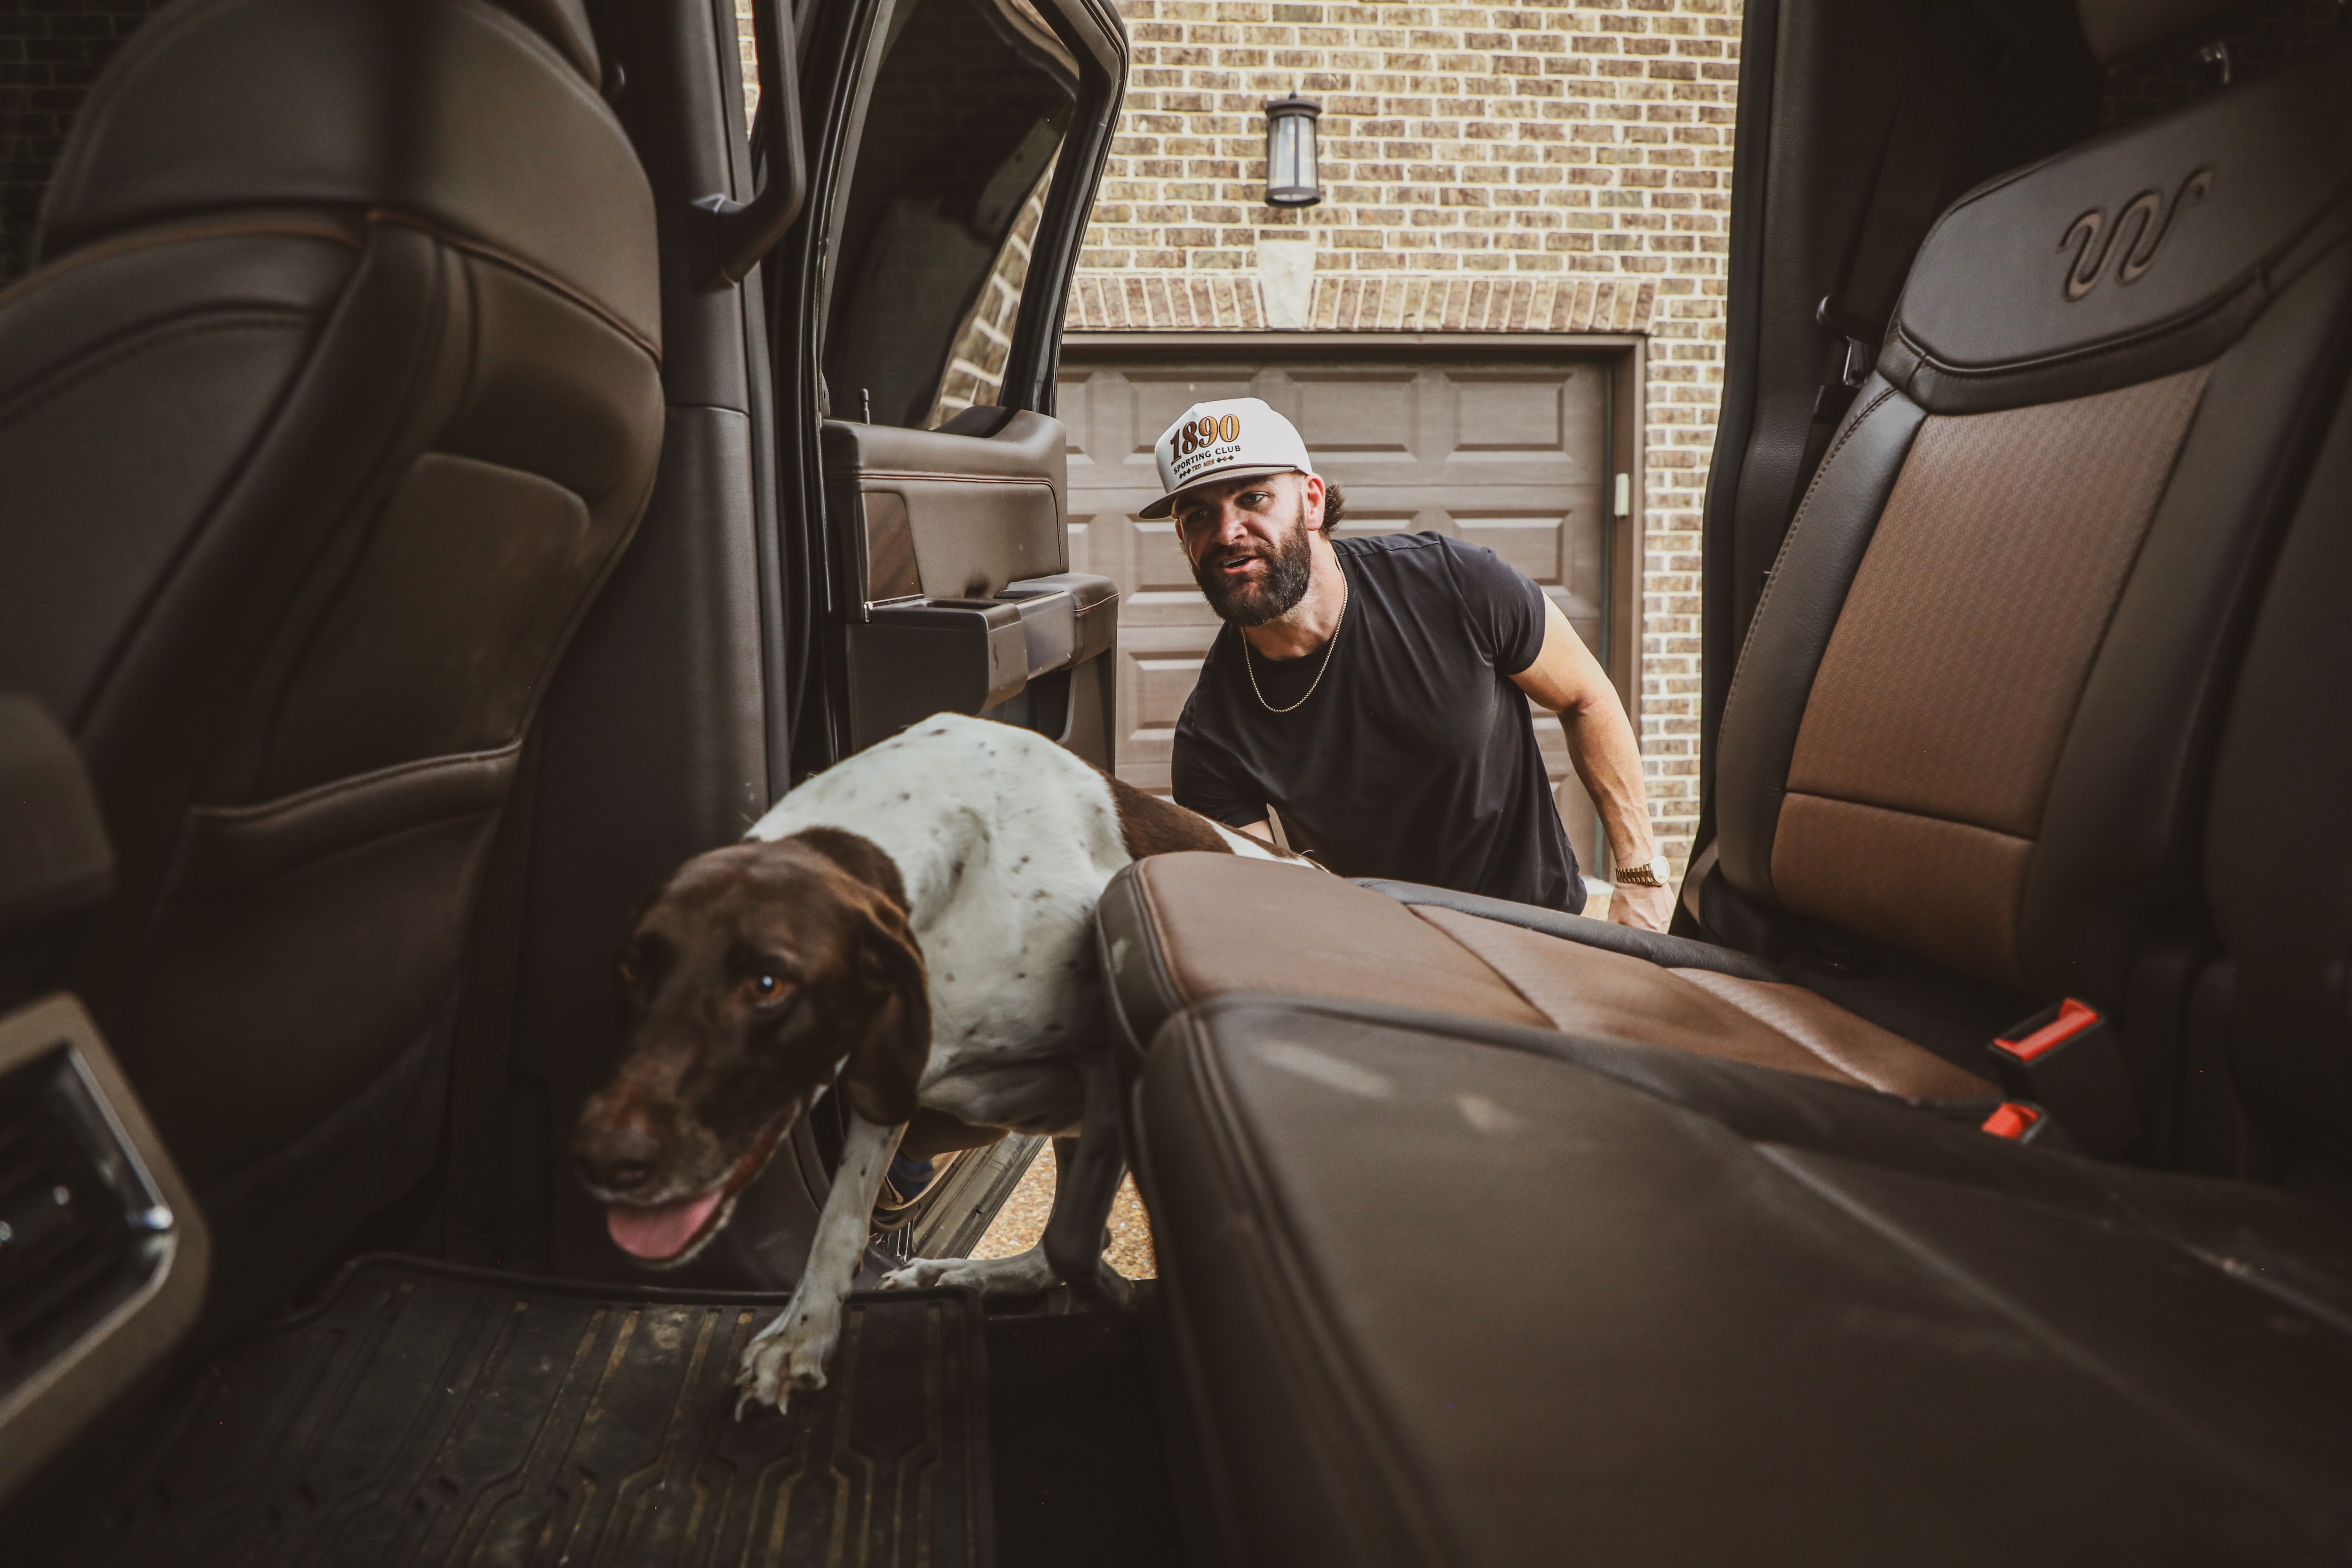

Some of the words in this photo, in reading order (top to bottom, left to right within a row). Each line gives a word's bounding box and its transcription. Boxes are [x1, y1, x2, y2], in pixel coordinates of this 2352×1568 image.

[1170, 414, 1240, 466] 1890
[1174, 451, 1211, 474] SPORTING
[1215, 445, 1240, 454] CLUB
[1203, 459, 1215, 467] MRK
